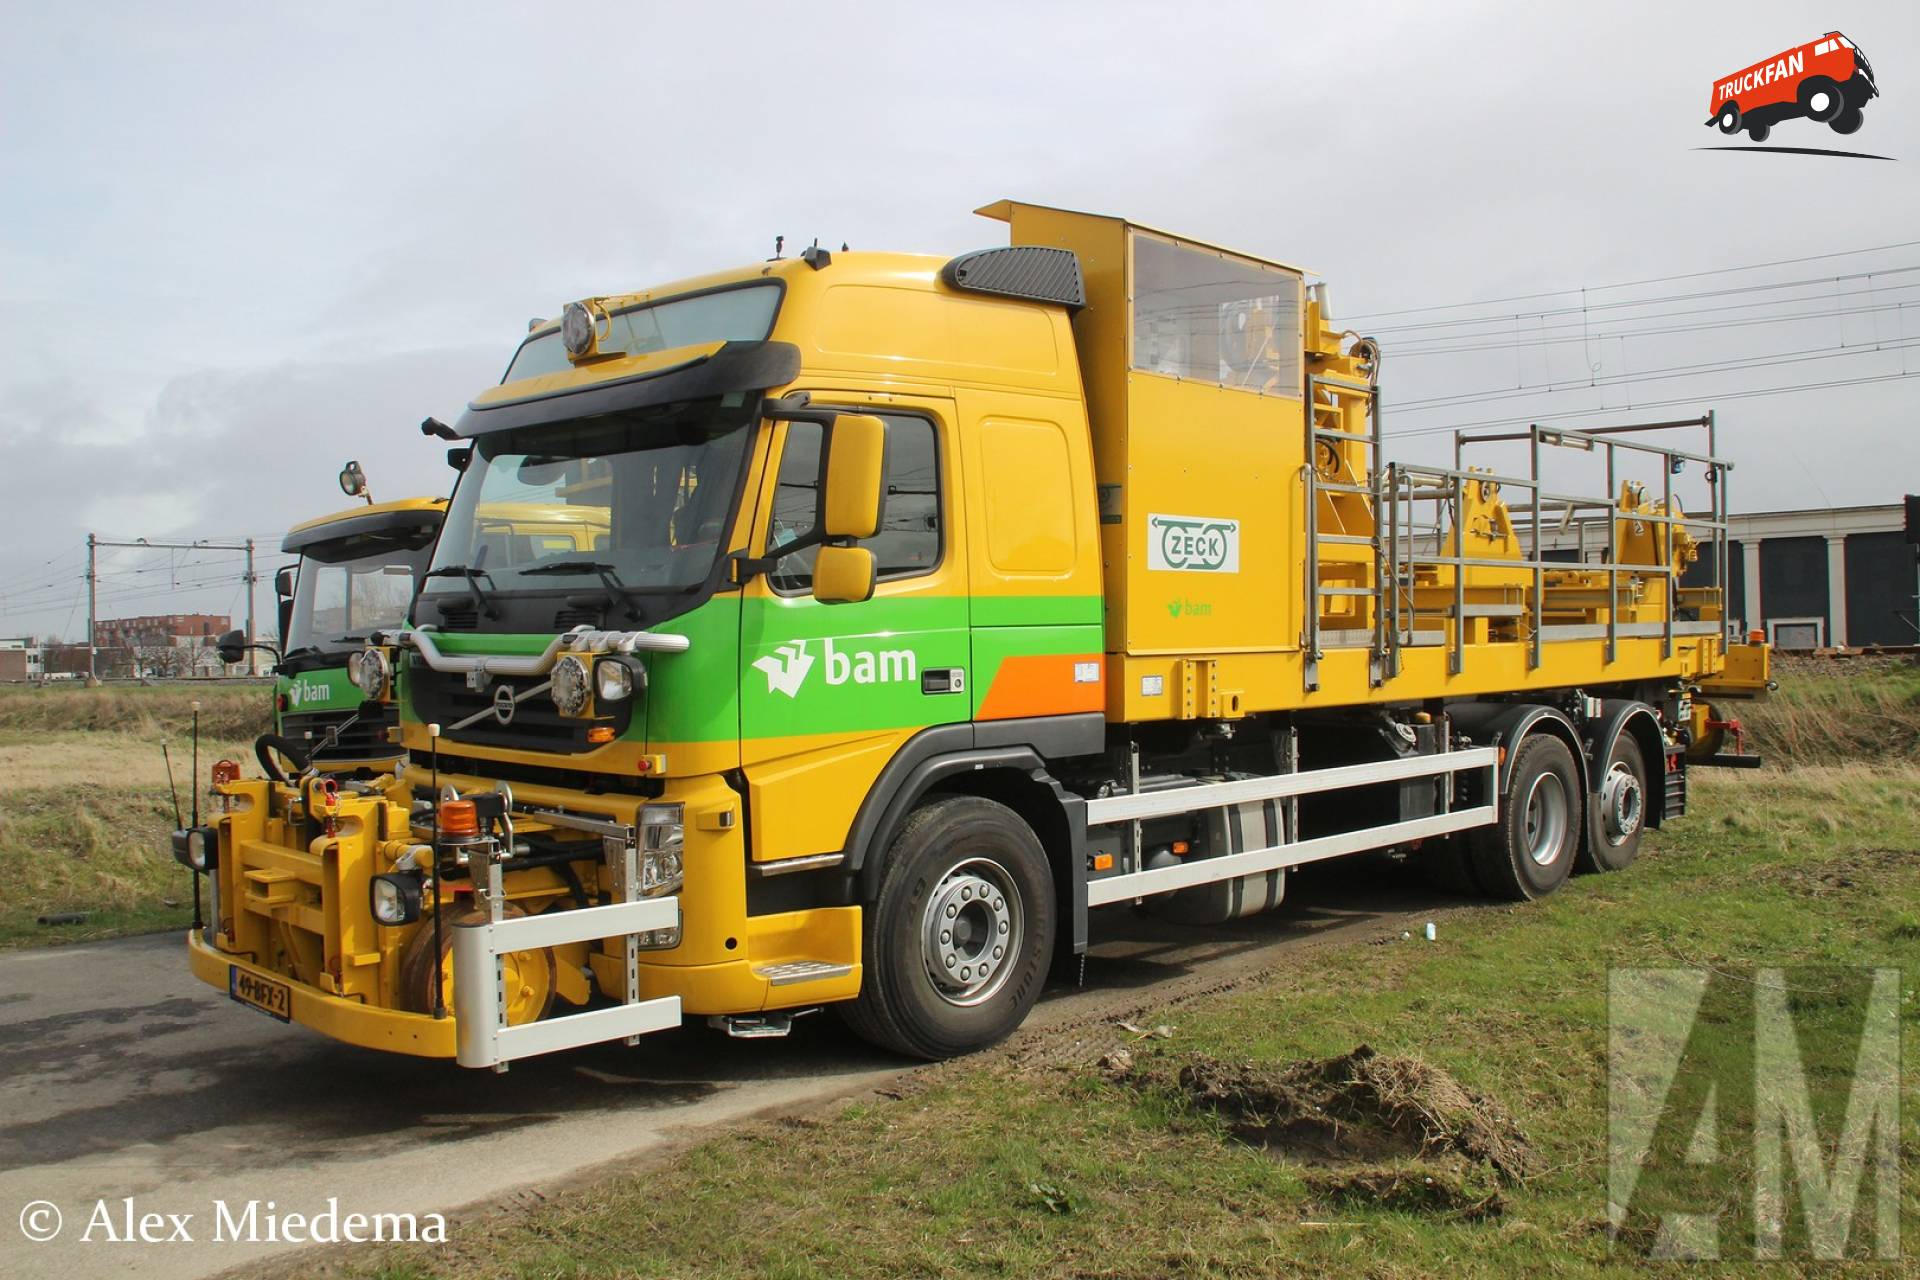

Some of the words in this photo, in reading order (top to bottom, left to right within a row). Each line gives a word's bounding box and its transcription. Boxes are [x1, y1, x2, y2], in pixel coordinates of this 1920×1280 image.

[1171, 535, 1219, 557] ZECK
[1184, 598, 1212, 616] bam
[824, 638, 917, 685] bam
[302, 680, 330, 702] bam
